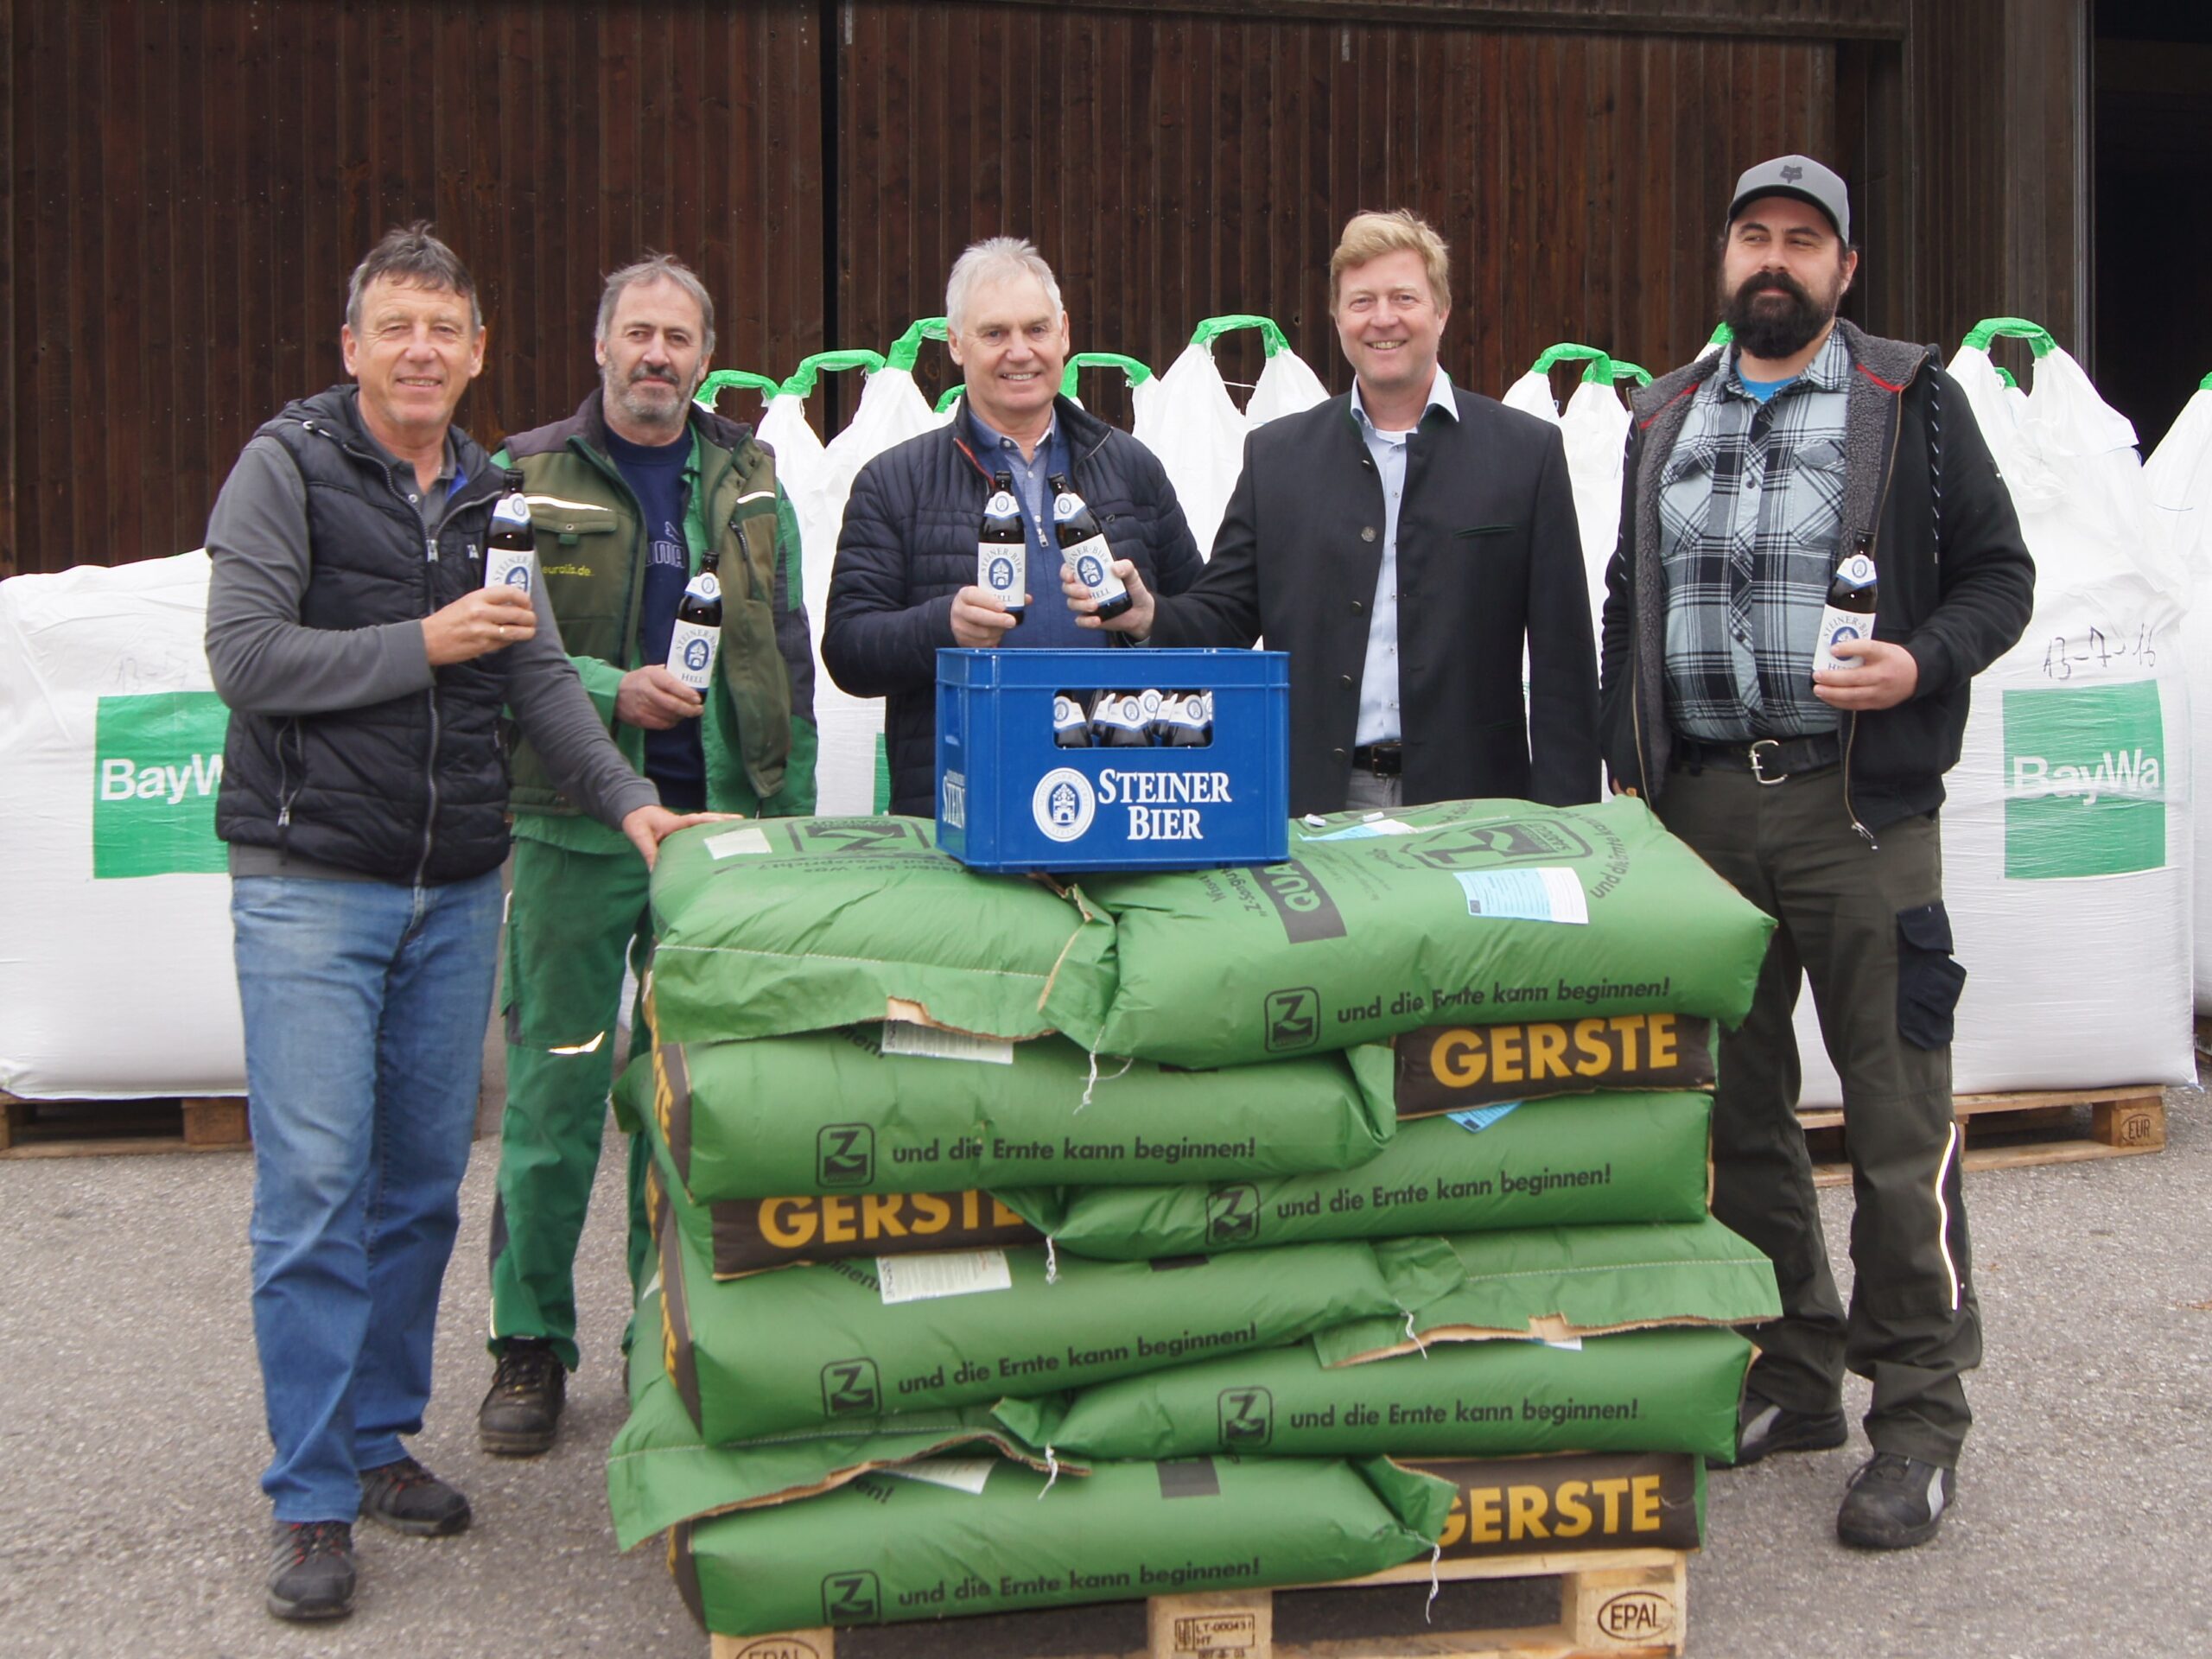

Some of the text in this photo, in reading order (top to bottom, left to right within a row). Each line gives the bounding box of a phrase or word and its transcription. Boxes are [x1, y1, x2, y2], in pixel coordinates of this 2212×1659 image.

[100, 753, 224, 804] BayW
[1098, 767, 1233, 804] STEINER
[2012, 747, 2160, 806] BayWa
[1127, 805, 1203, 841] BIER
[1337, 977, 1671, 1025] und die Ernte kann beginnen!
[1429, 1012, 1678, 1089] GERSTE
[892, 1135, 1256, 1165] und die Ernte kann beginnen!
[2128, 1118, 2151, 1139] EUR
[1276, 1163, 1612, 1220] und die Ernte kann beginnen!
[898, 1322, 1258, 1395] und die Ernte kann beginnen!
[1290, 1399, 1639, 1429] und die Ernte kann beginnen!
[898, 1556, 1261, 1608] und die Ernte kann beginnen!
